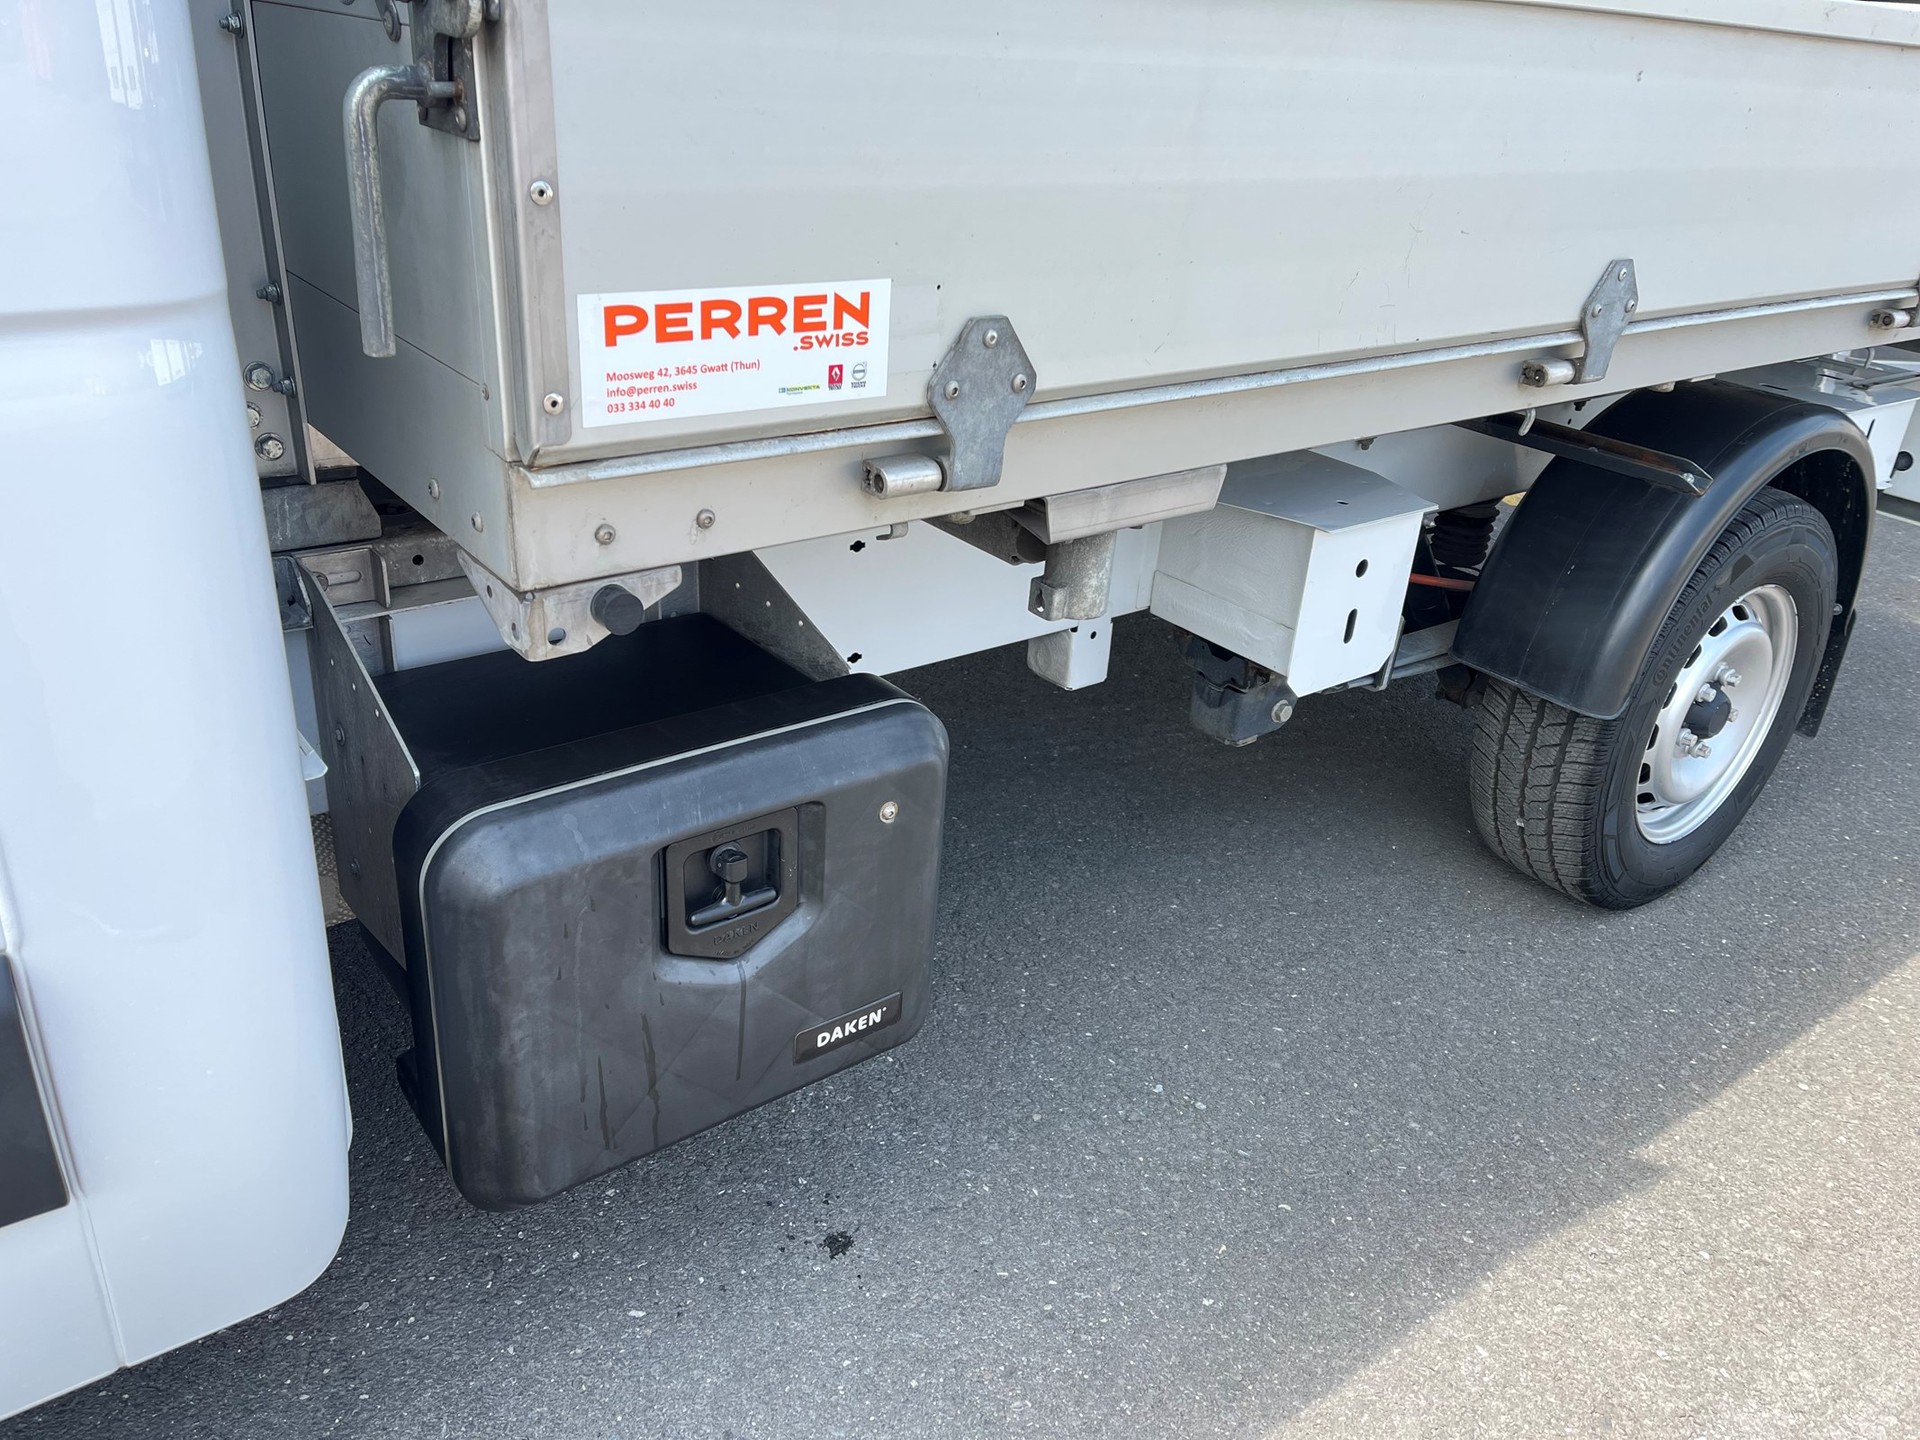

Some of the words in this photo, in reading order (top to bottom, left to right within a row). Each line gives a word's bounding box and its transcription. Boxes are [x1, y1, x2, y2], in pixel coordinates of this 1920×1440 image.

[603, 291, 870, 347] PERREN
[793, 331, 870, 351] .SWISS
[606, 369, 655, 382] Moosweg
[657, 367, 672, 379] 42,
[674, 365, 698, 377] 3645
[700, 362, 728, 374] Gwatt
[730, 359, 761, 373] (Thun)
[606, 380, 698, 398] info@perren.swiss
[607, 402, 626, 414] 033
[628, 400, 646, 412] 334
[648, 398, 661, 409] 40
[663, 397, 675, 408] 40
[1652, 594, 1713, 687] Continental
[713, 921, 759, 946] DAKEN
[816, 1009, 883, 1049] DAKEN
